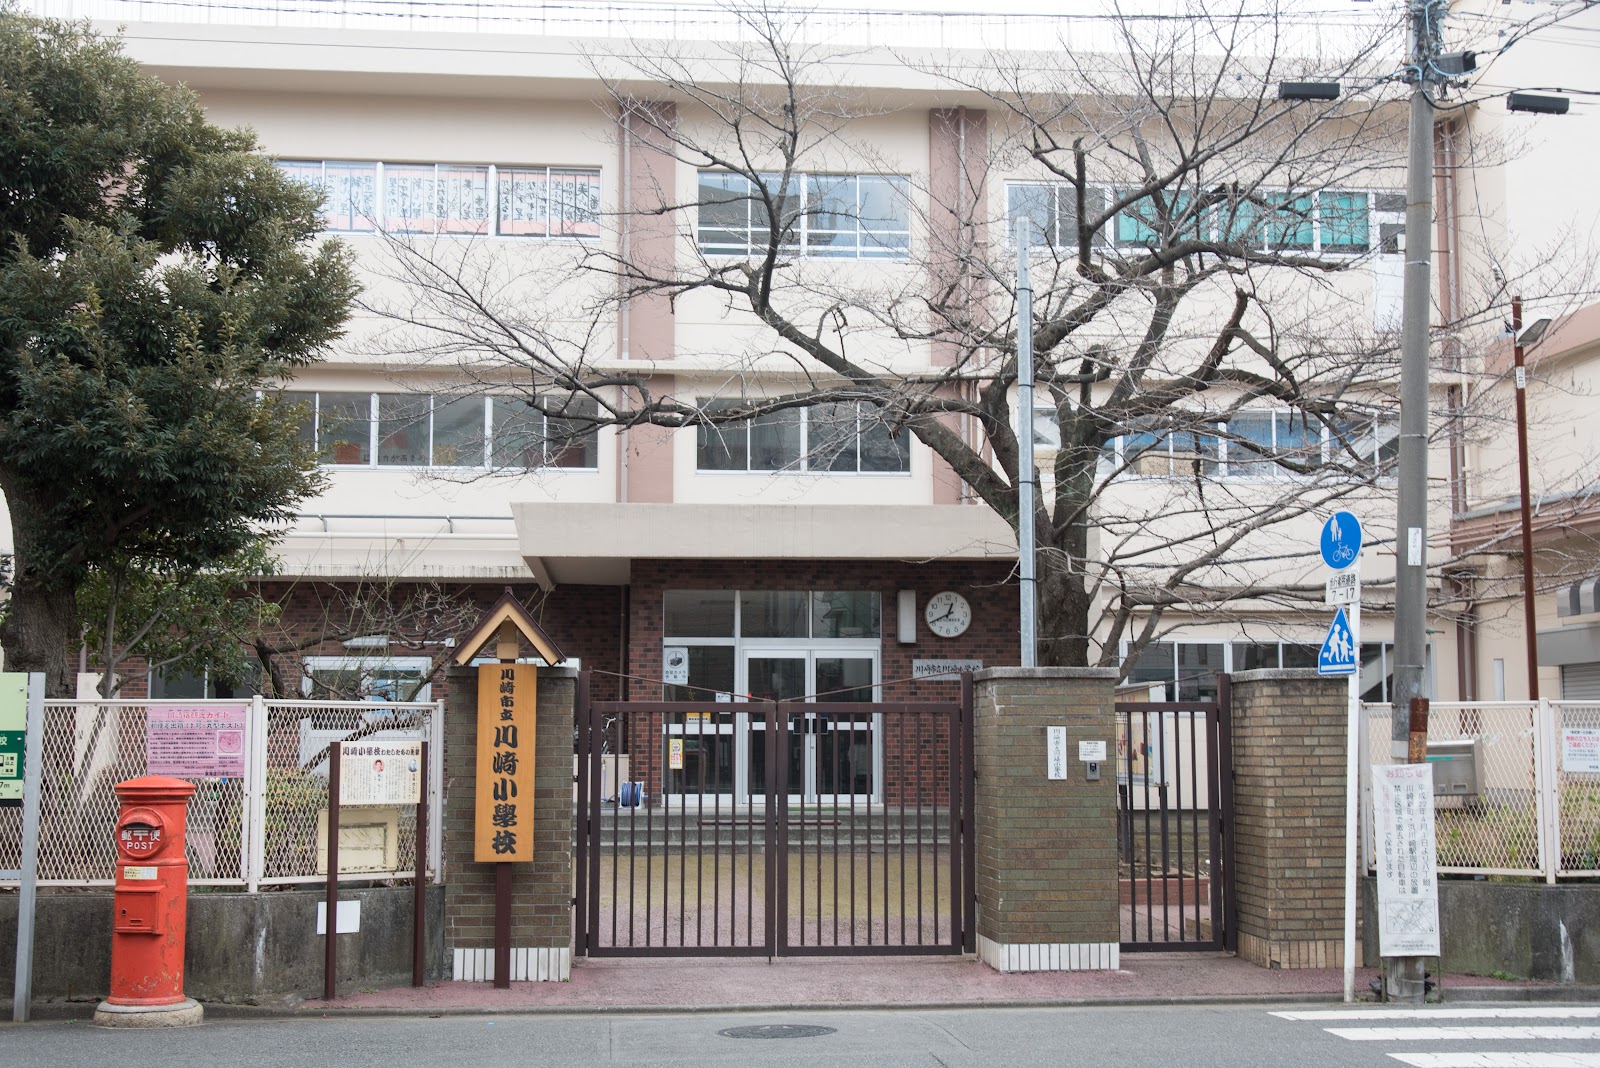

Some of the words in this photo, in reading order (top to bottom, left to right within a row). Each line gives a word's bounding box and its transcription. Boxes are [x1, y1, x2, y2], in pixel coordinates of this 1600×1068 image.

[1332, 588, 1354, 601] 7-17
[1386, 768, 1424, 778] お知らせ
[126, 842, 153, 850] POST
